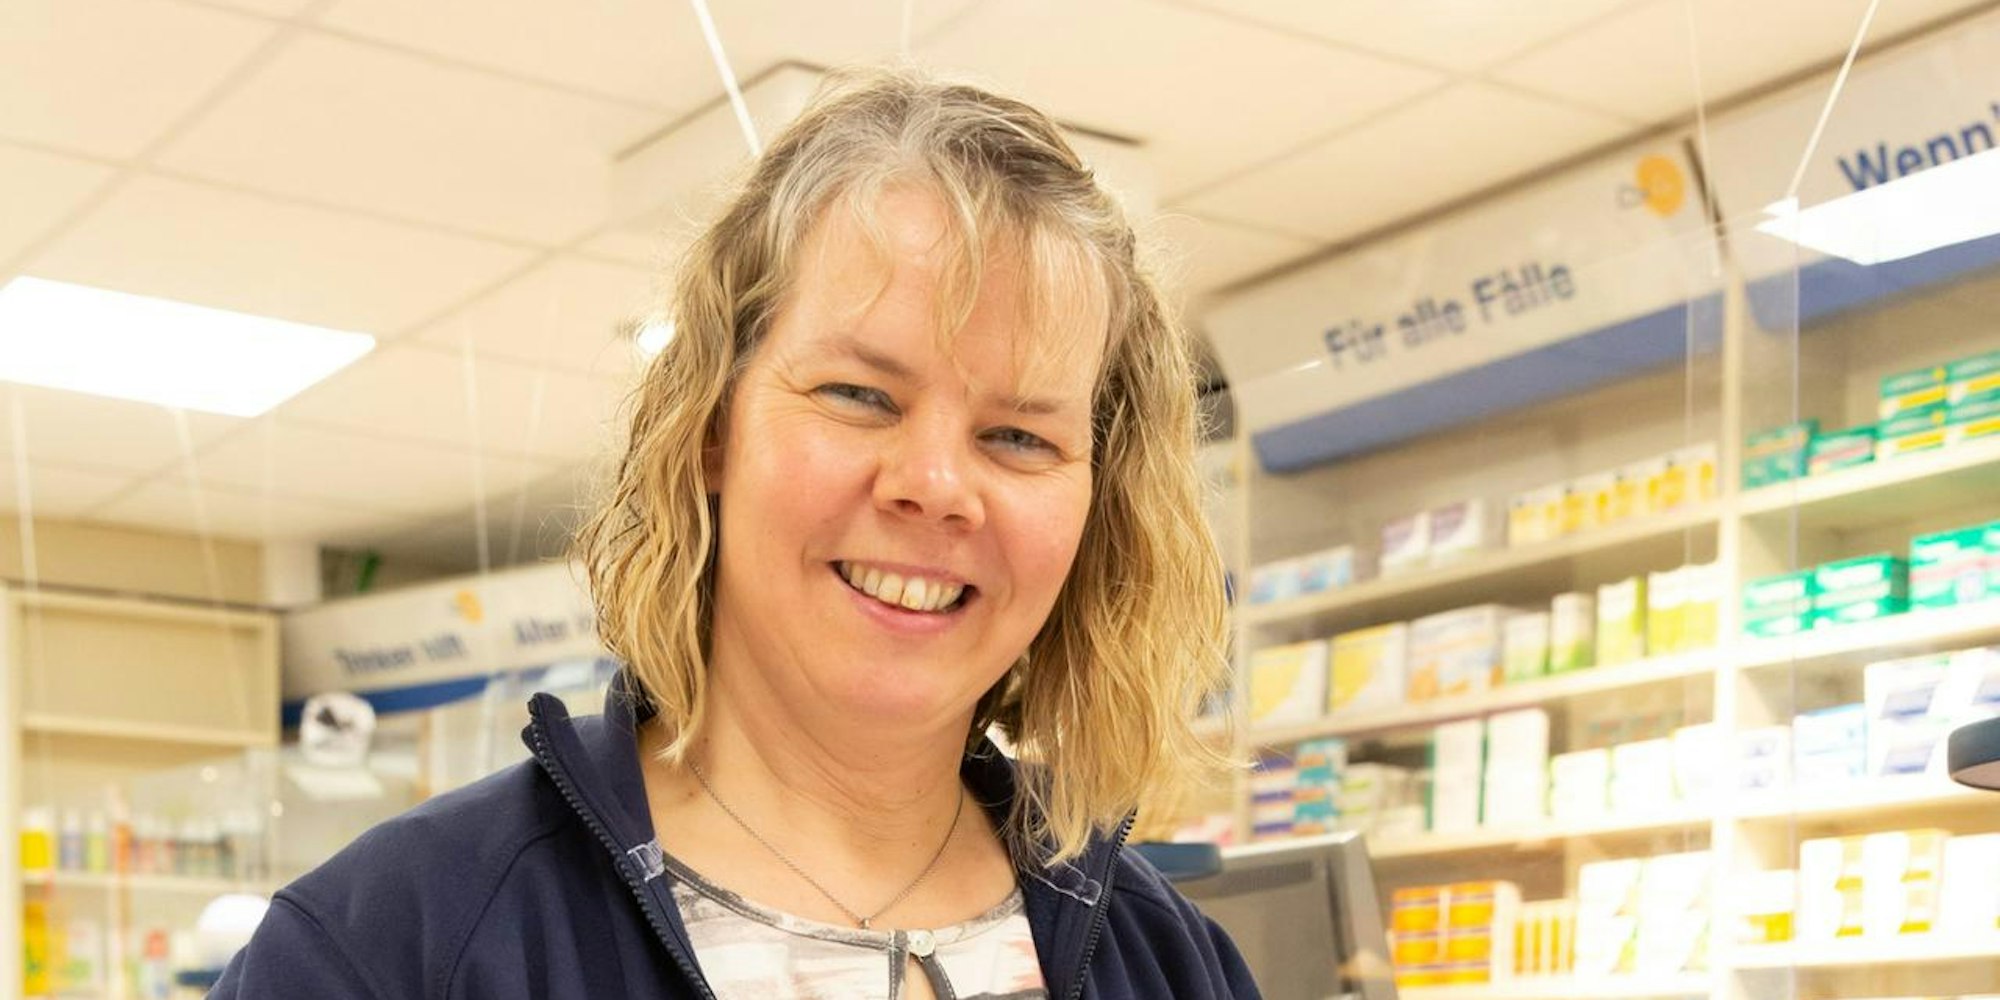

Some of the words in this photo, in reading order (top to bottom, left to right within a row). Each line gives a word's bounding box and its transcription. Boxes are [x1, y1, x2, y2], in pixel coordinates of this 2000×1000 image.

[1324, 318, 1386, 371] Für
[1397, 296, 1466, 347] alle
[1471, 262, 1576, 324] Fälle
